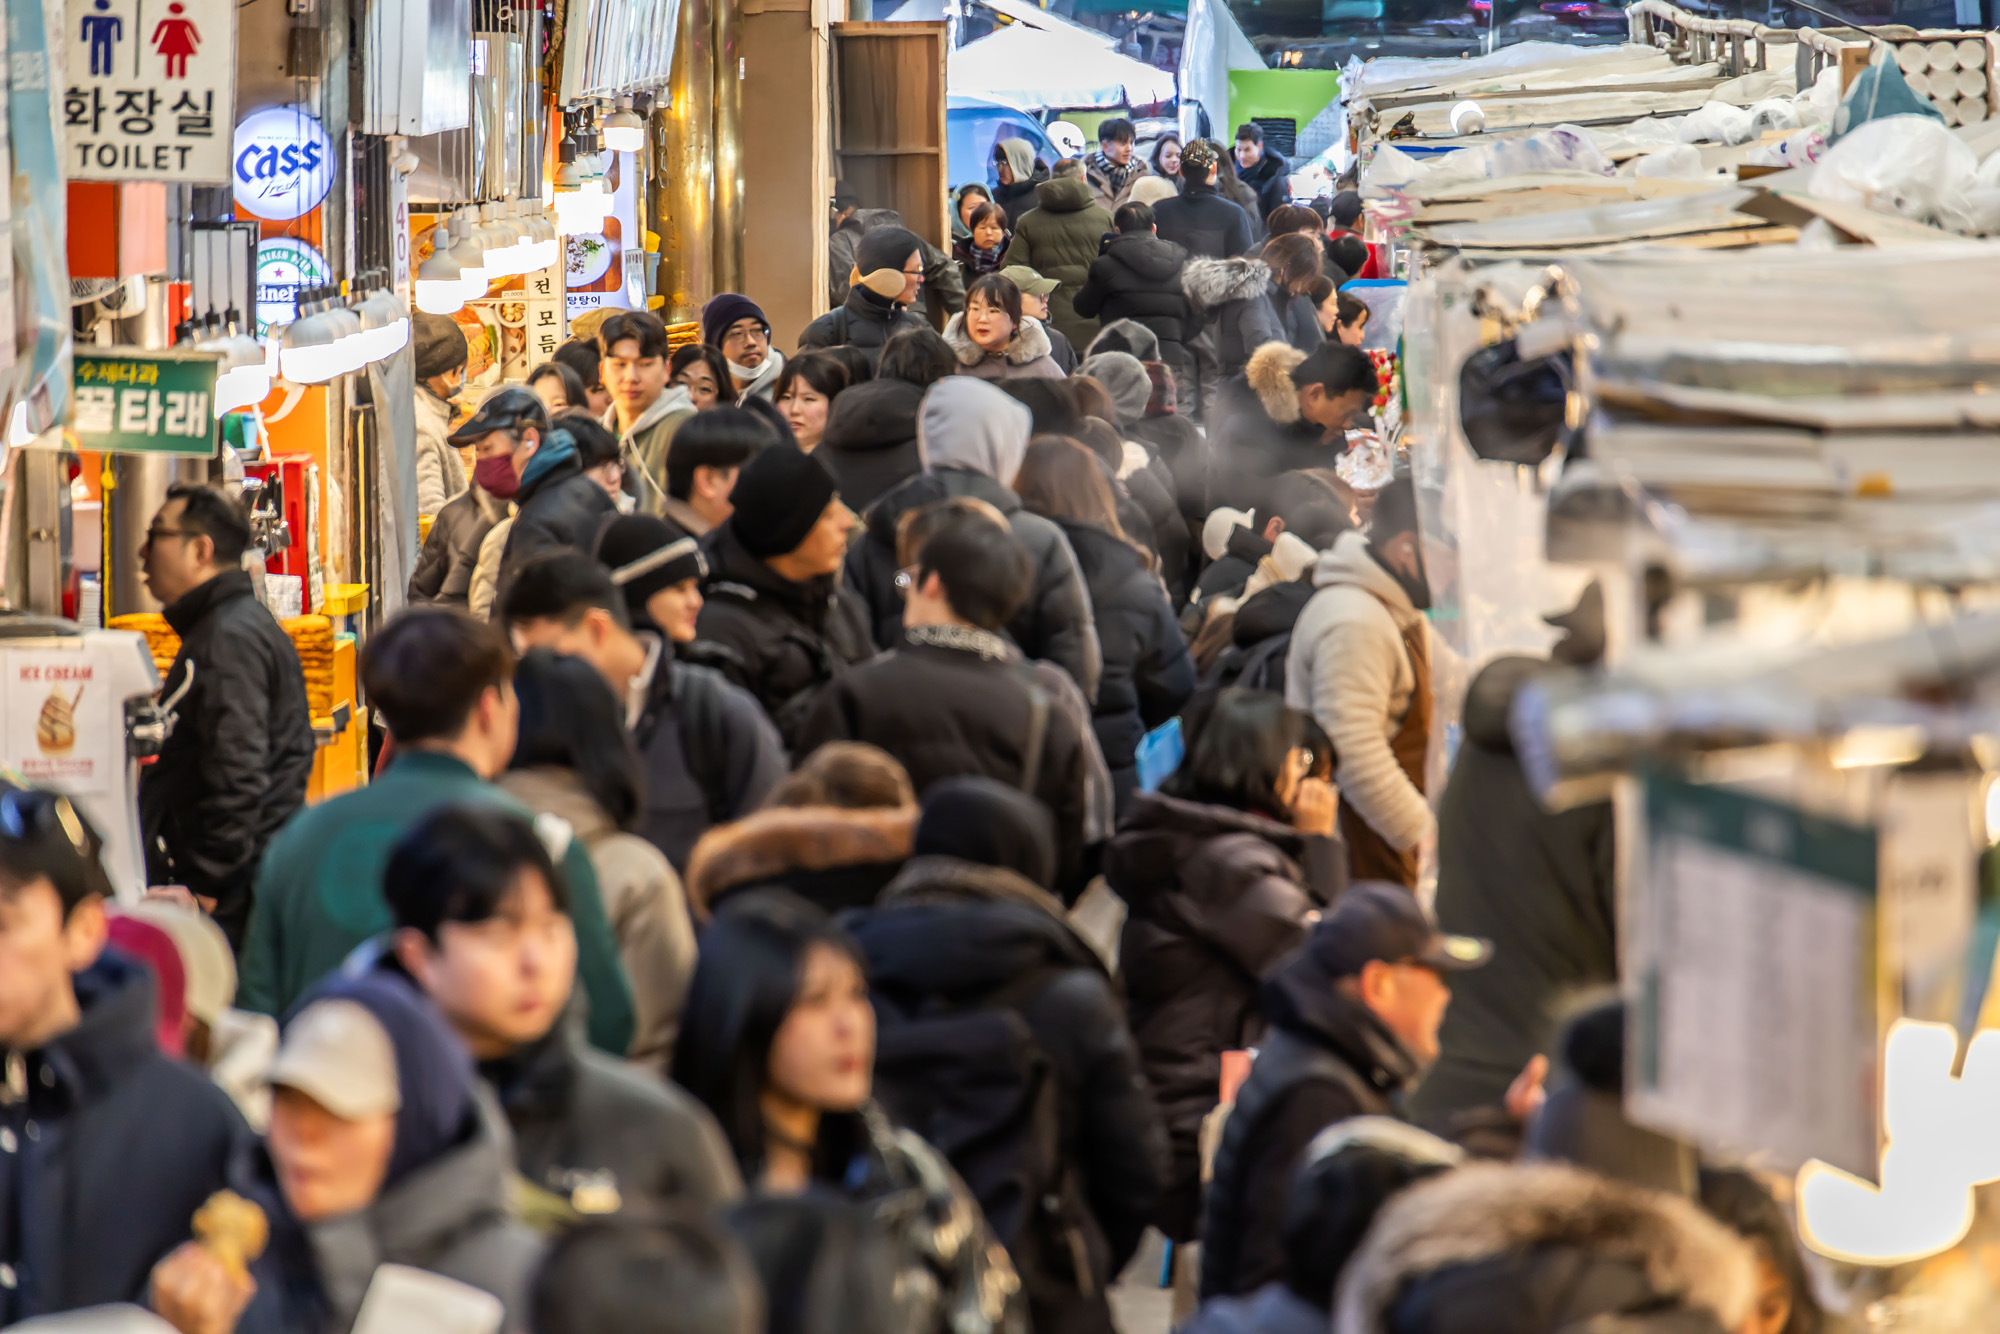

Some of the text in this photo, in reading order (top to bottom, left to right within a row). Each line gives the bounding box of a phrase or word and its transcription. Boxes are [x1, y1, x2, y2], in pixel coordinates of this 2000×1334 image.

[65, 86, 215, 137] 화장실
[76, 143, 193, 171] TOILET
[235, 140, 321, 184] Cass
[74, 386, 208, 438] 꿀타래
[44, 664, 94, 682] CREAM
